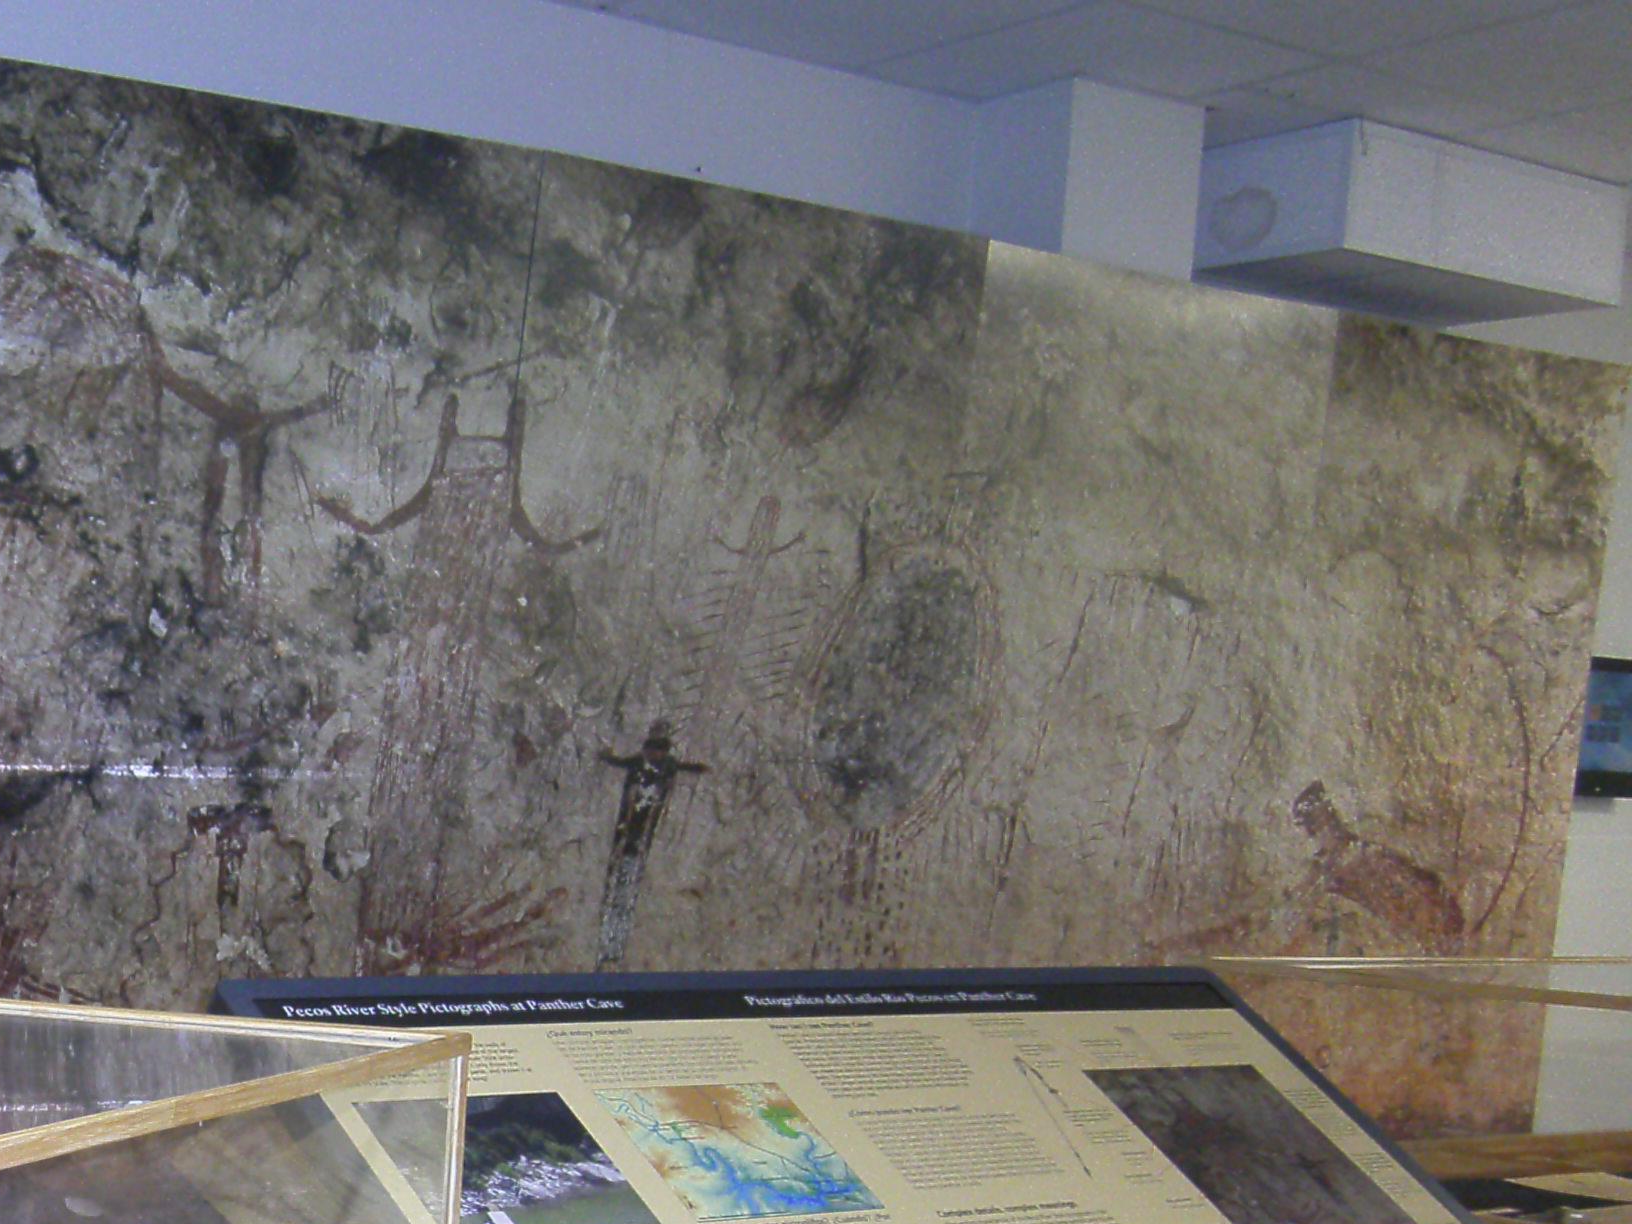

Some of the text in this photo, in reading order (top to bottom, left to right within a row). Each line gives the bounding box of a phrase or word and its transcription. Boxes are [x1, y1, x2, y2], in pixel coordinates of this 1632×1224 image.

[282, 997, 625, 1018] Pecos River Style Pictographs at Panther Cave
